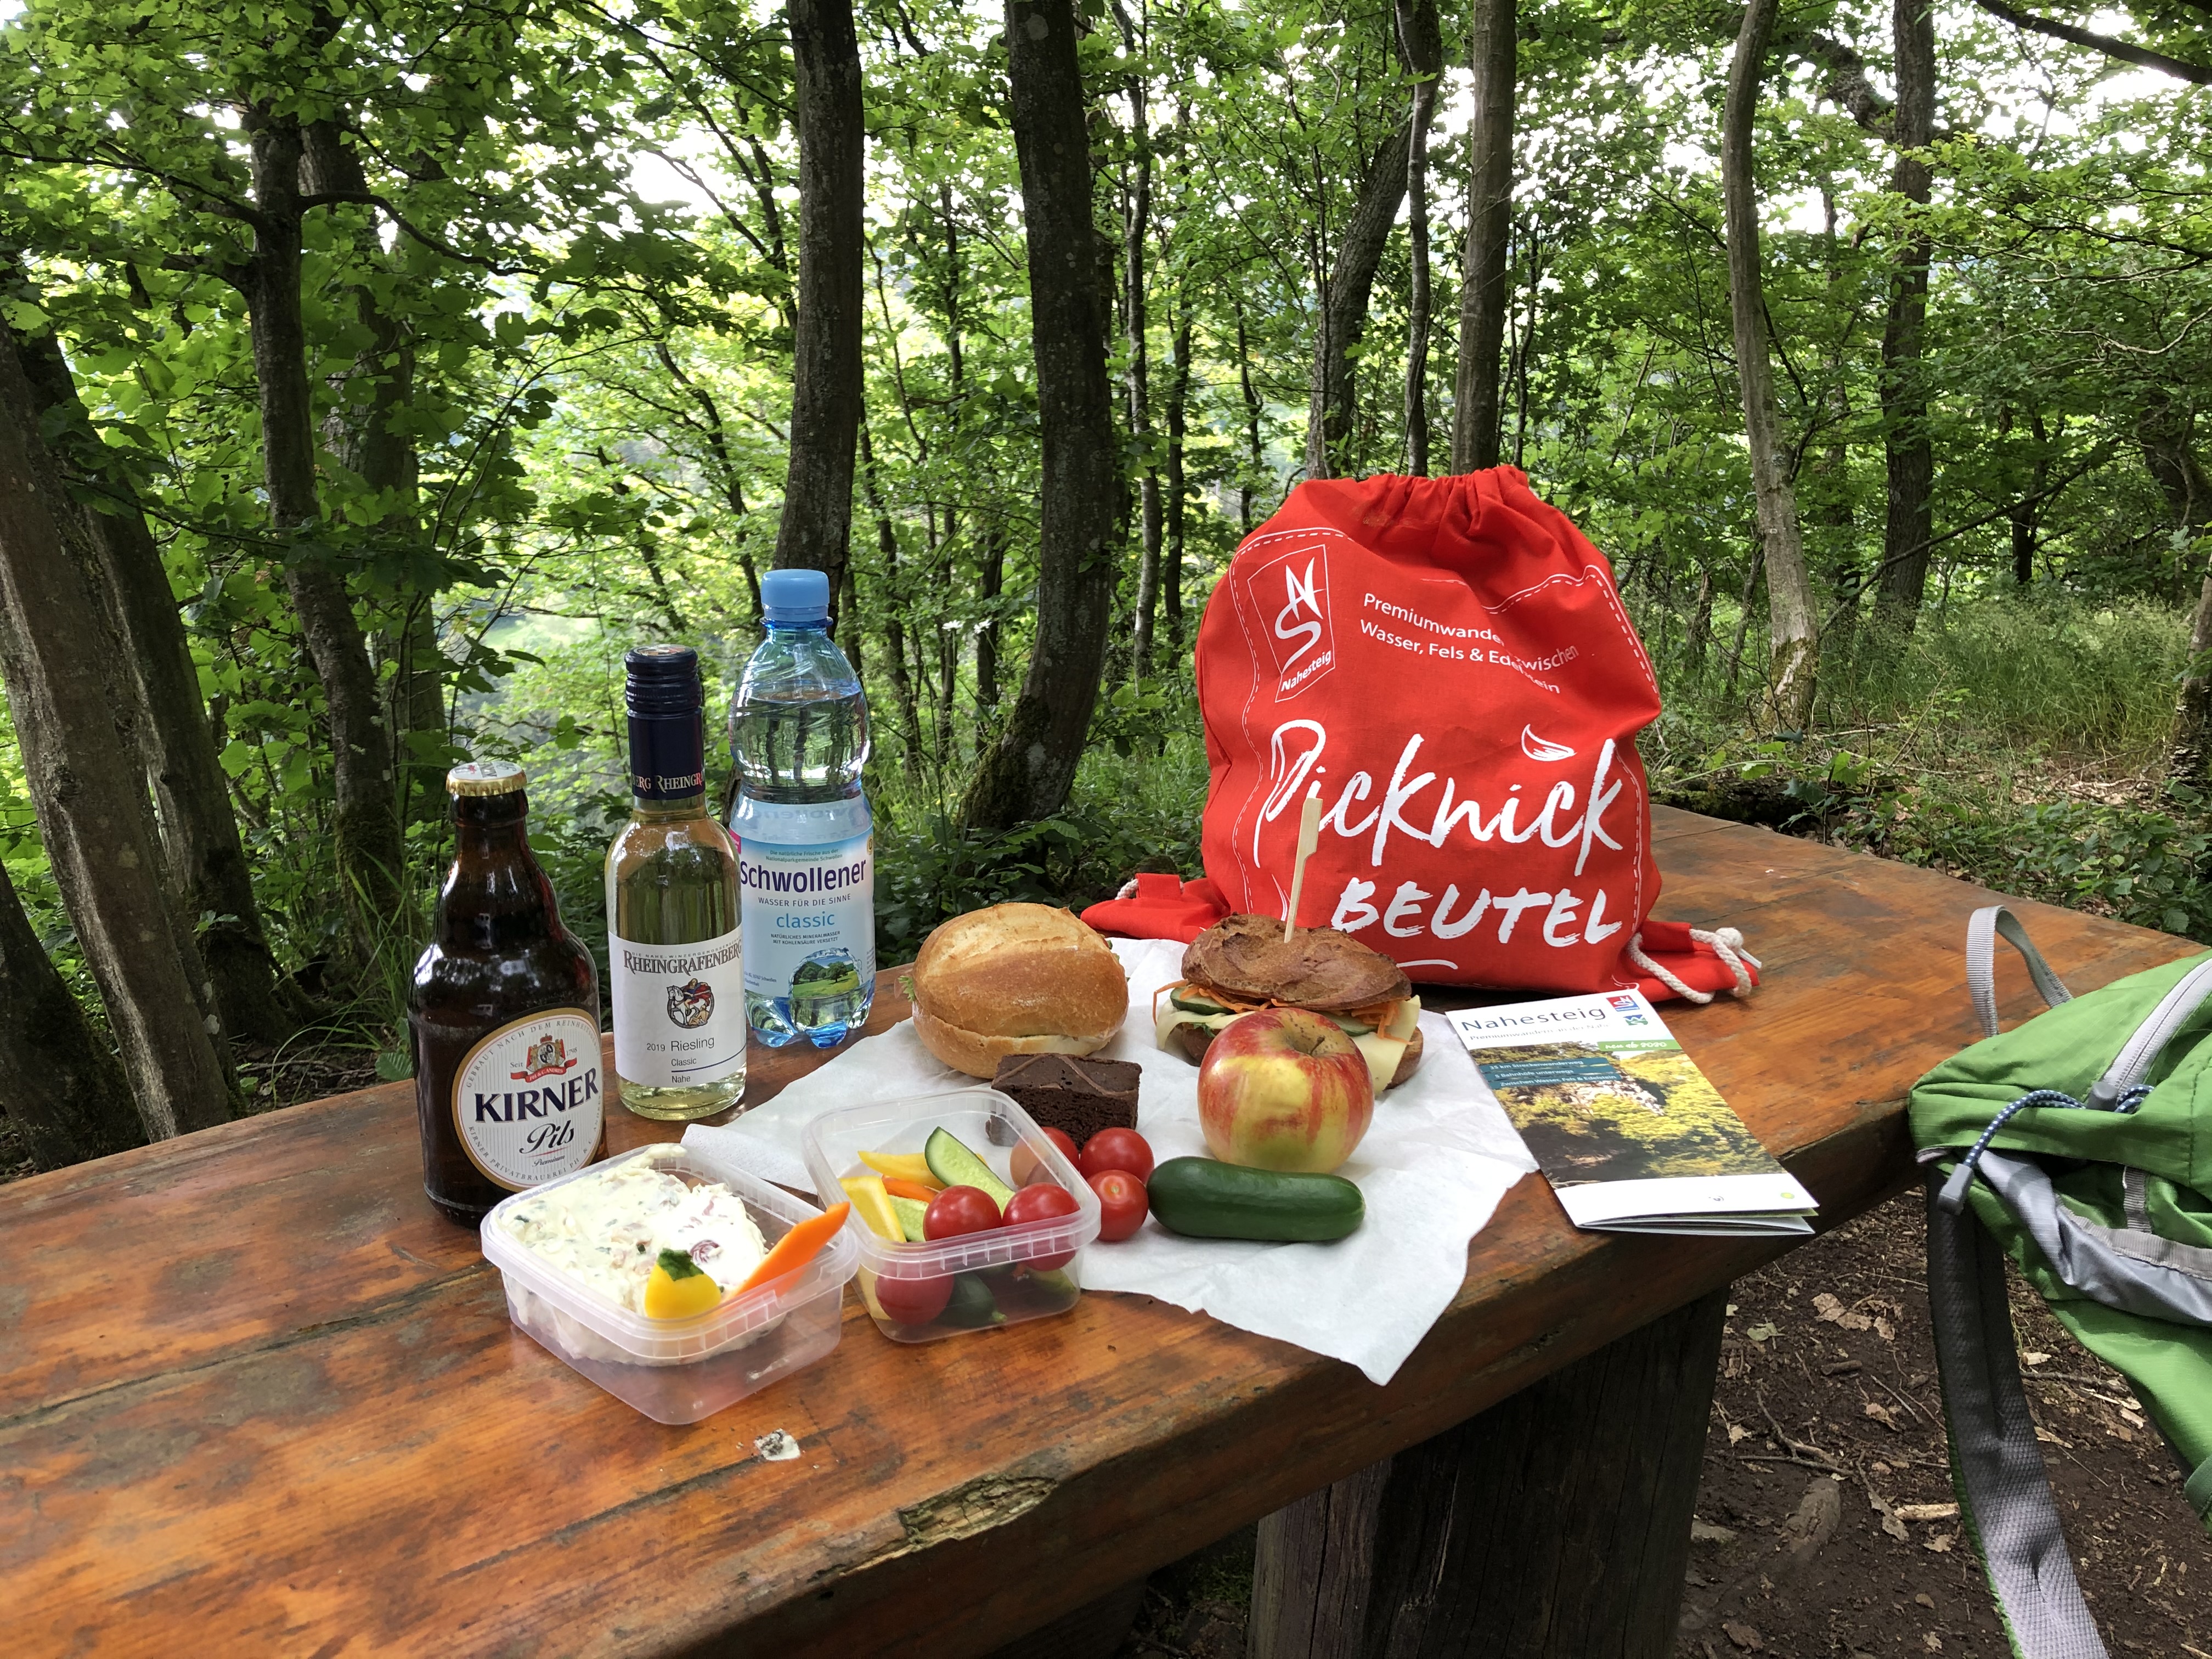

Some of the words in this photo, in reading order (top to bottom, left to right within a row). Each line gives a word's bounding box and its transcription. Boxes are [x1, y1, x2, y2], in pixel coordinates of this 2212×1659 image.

[1360, 619, 1424, 654] Wasser,
[1429, 642, 1464, 660] Fels
[1469, 648, 1483, 662] &
[1280, 650, 1331, 692] Nahesteig
[1253, 719, 1623, 877] Picknick
[741, 859, 866, 893] Schwollener
[758, 896, 789, 906] WASSER
[793, 898, 809, 907] FÜR
[829, 893, 851, 904] SINNE
[1330, 877, 1623, 947] BEUTEL
[776, 911, 835, 928] classic
[803, 930, 840, 939] MINERALWASSER
[623, 939, 742, 976] RHEINGRAFENBERG
[1462, 1007, 1606, 1031] Nahesteig
[466, 1050, 494, 1088] GEBRAUT
[497, 1031, 525, 1049] NACH
[531, 1022, 551, 1033] DEM
[647, 1043, 665, 1052] 2019
[671, 1037, 714, 1052] Riesling
[671, 1058, 697, 1066] Classic
[1512, 1060, 1584, 1069] Streckenwanderweg
[475, 1067, 599, 1123] KIRNER
[1500, 1079, 1534, 1087] Zwischen
[469, 1126, 489, 1158] KIRNER
[490, 1158, 567, 1181] PRIVATBRAUEREI
[569, 1158, 579, 1168] PH
[518, 1119, 574, 1154] Pils
[532, 1155, 566, 1167] Premium
